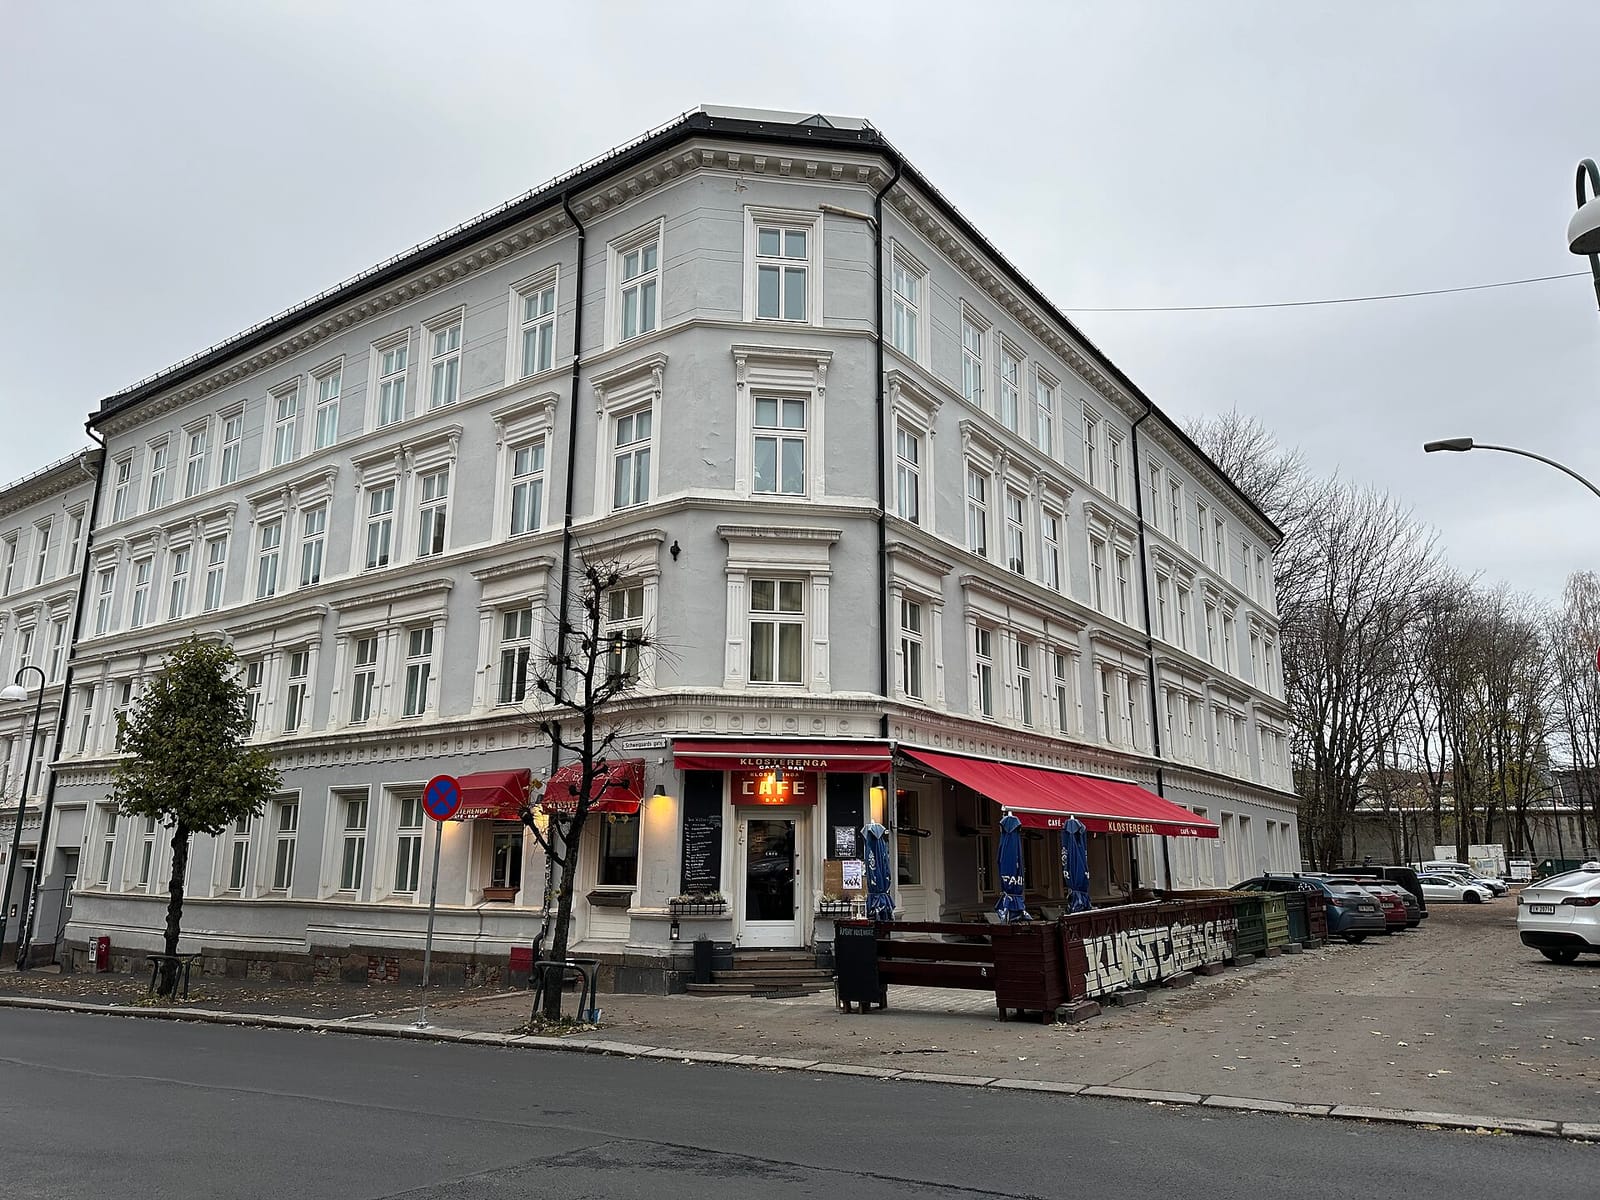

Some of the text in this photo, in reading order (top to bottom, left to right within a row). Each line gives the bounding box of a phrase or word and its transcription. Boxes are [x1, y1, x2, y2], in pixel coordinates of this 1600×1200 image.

[740, 758, 828, 767] KLOSTERENGA
[742, 780, 806, 795] CAFE
[1108, 821, 1154, 834] KLOSTERENGA
